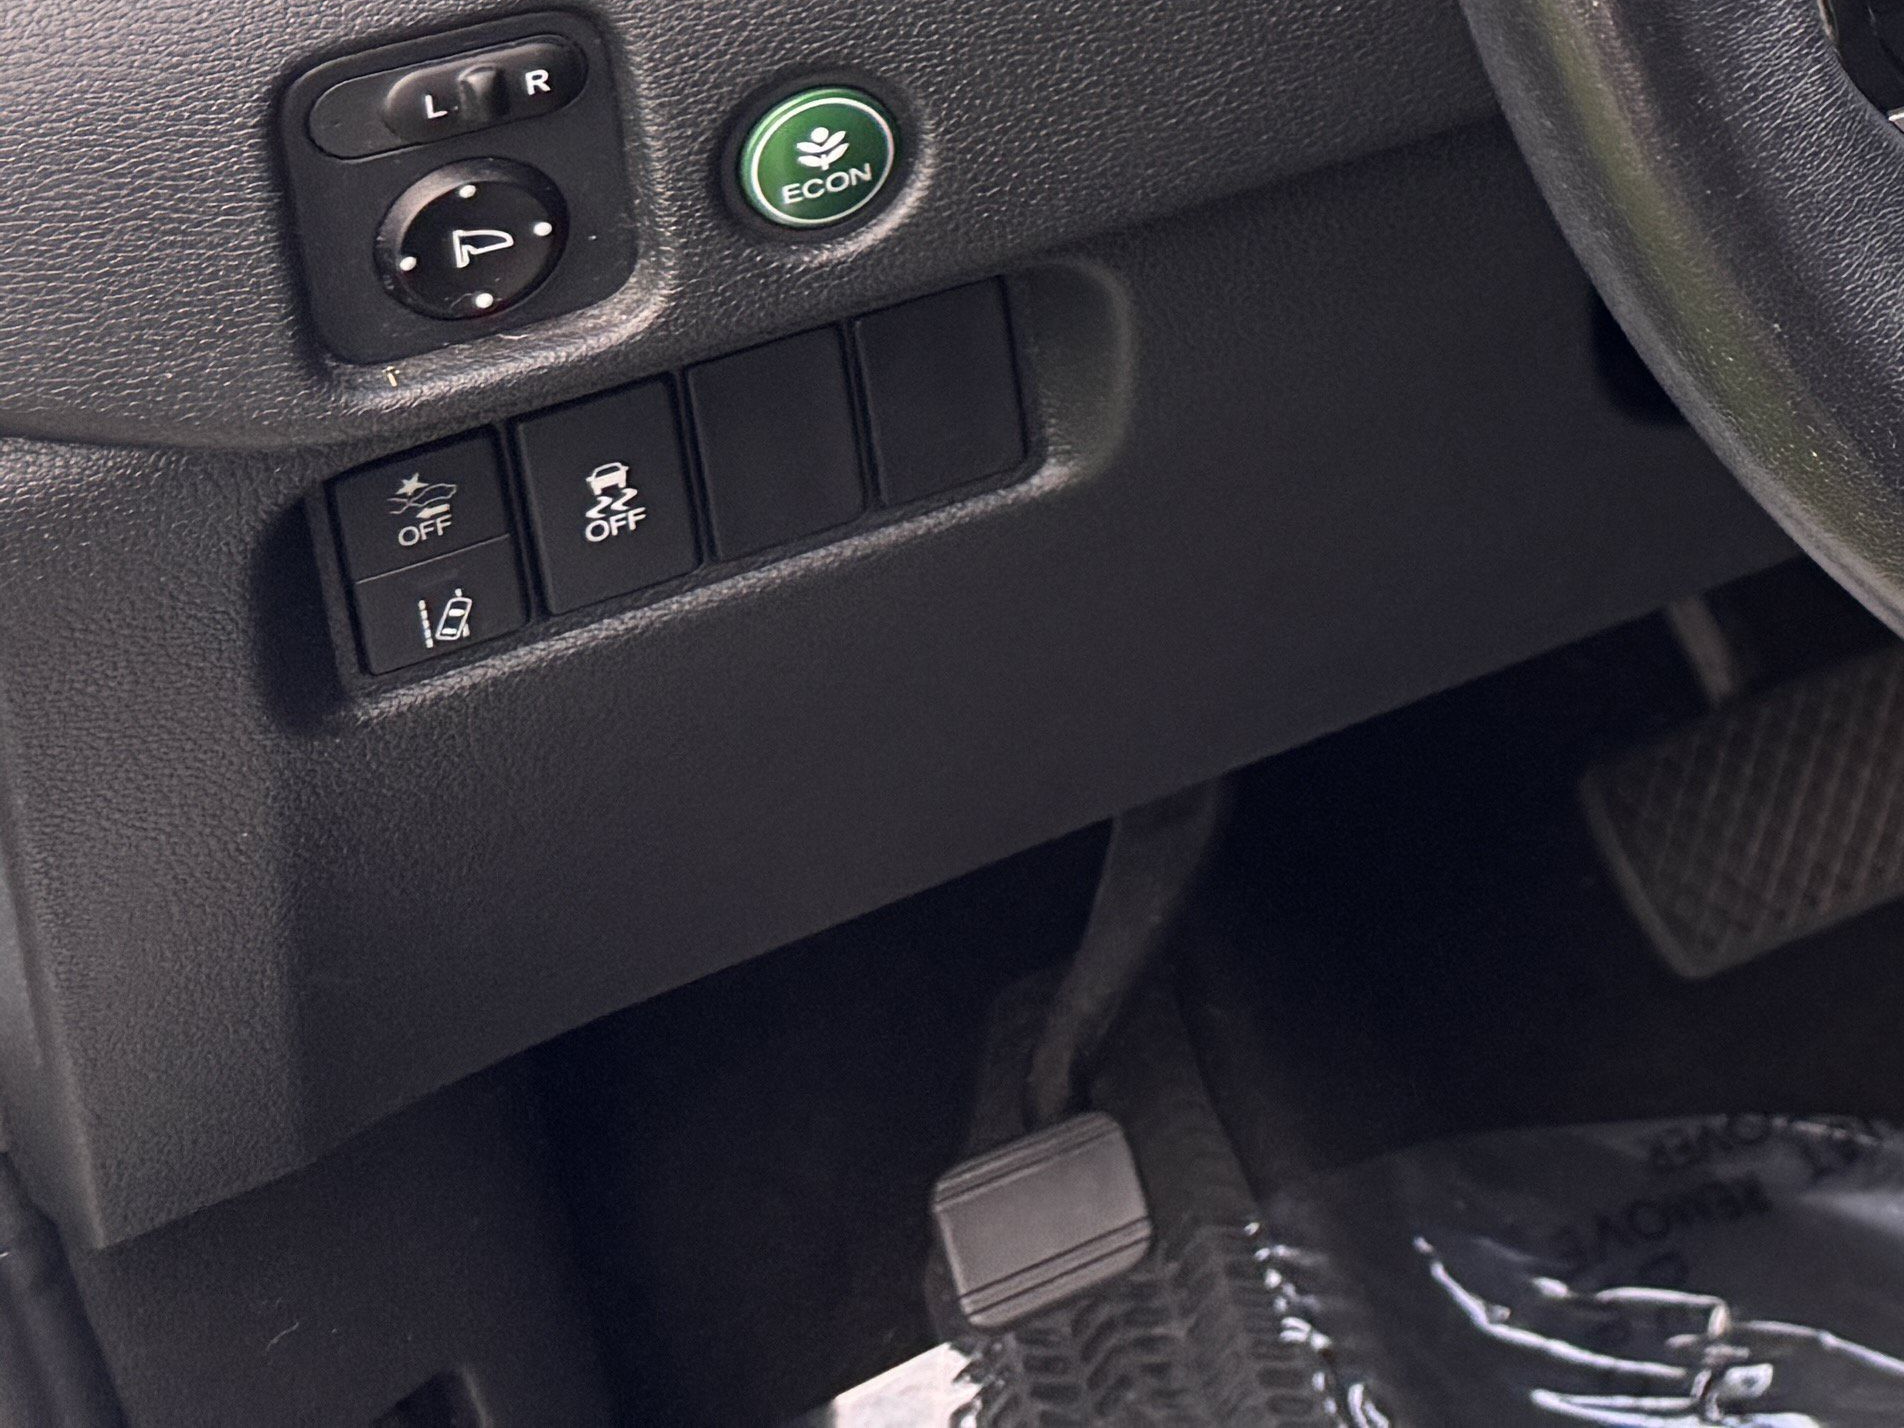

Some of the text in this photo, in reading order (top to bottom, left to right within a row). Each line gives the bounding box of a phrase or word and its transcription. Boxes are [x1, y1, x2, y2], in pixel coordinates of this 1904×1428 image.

[524, 68, 552, 97] R
[423, 94, 449, 120] L
[780, 161, 873, 206] ECON
[397, 513, 453, 547] OFF
[584, 505, 647, 543] OFF
